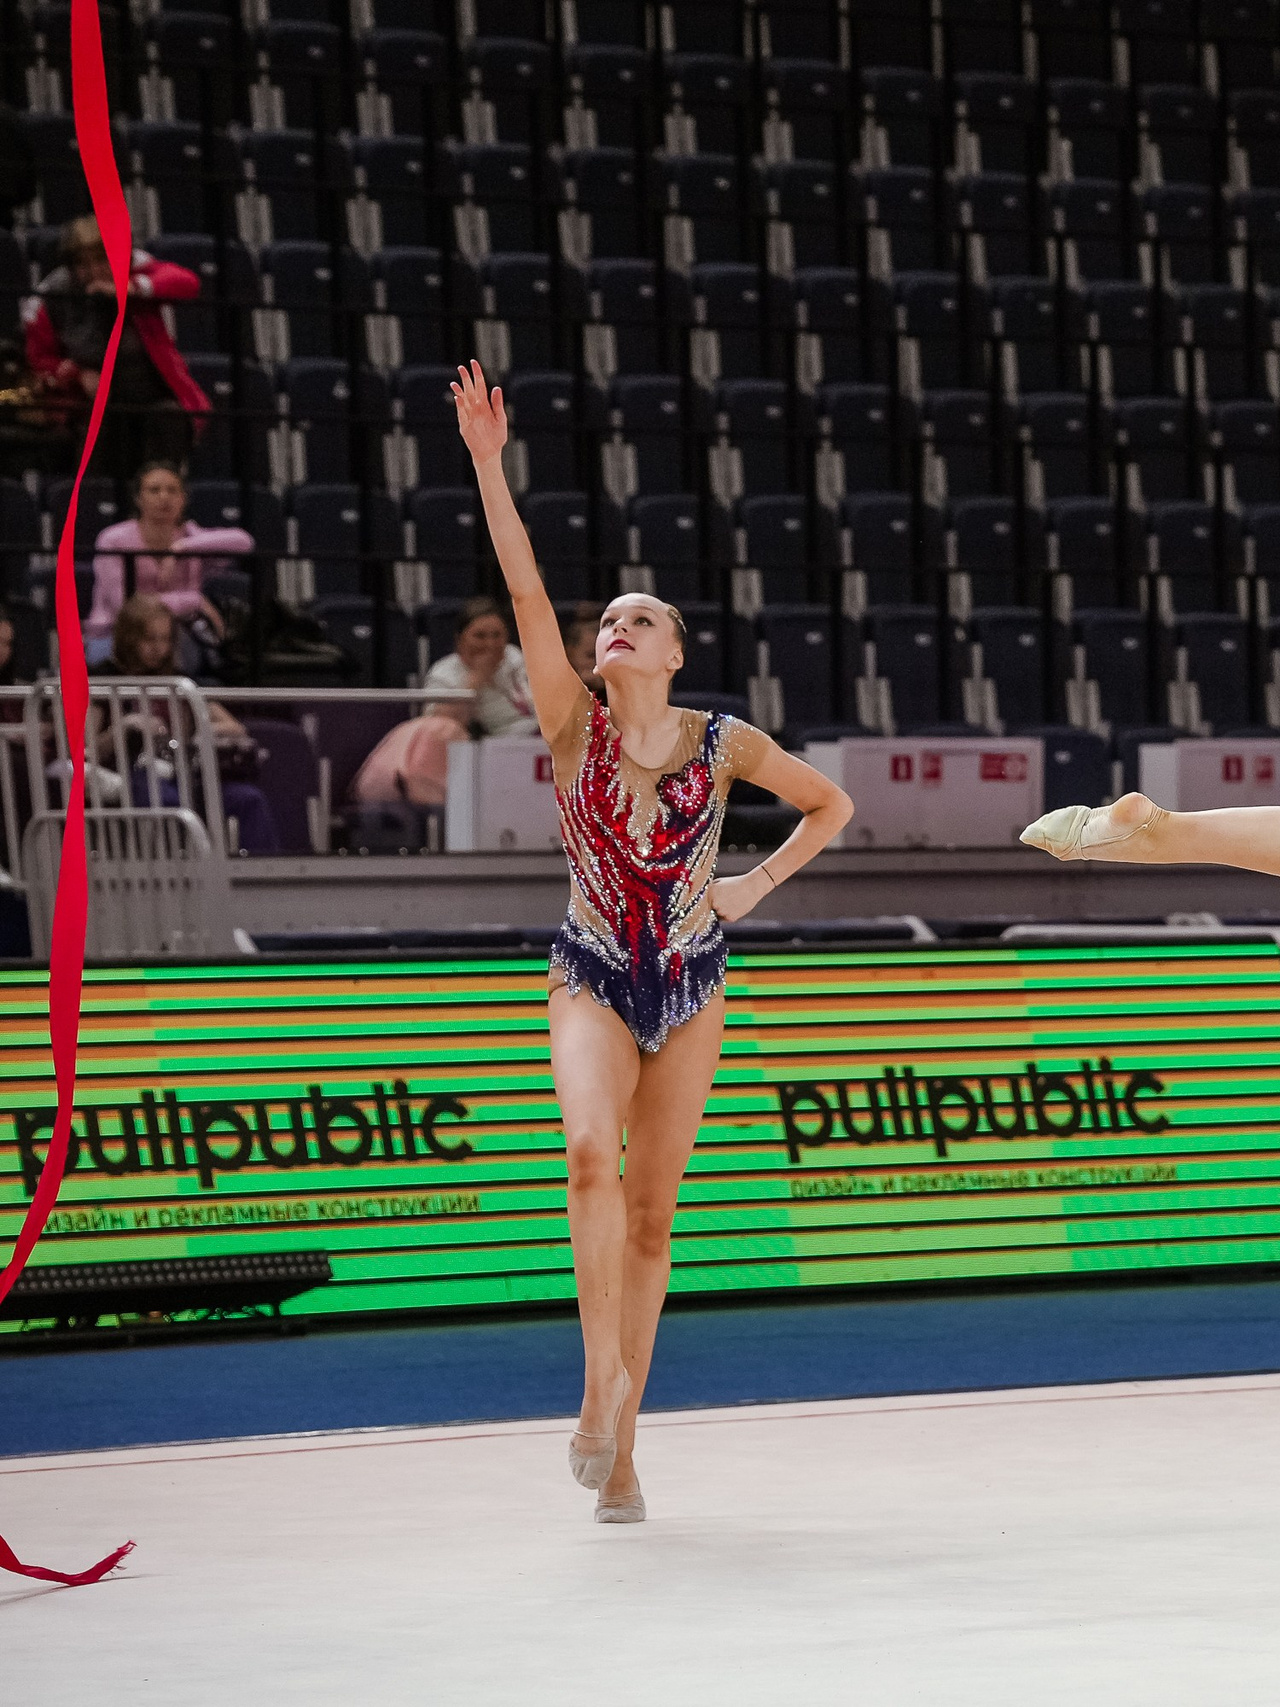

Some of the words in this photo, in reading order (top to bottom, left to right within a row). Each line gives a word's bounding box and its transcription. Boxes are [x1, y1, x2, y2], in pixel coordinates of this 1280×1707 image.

[15, 1078, 474, 1197] pullpublic
[780, 1057, 1170, 1164] pullpublic
[46, 1206, 124, 1233] изайн
